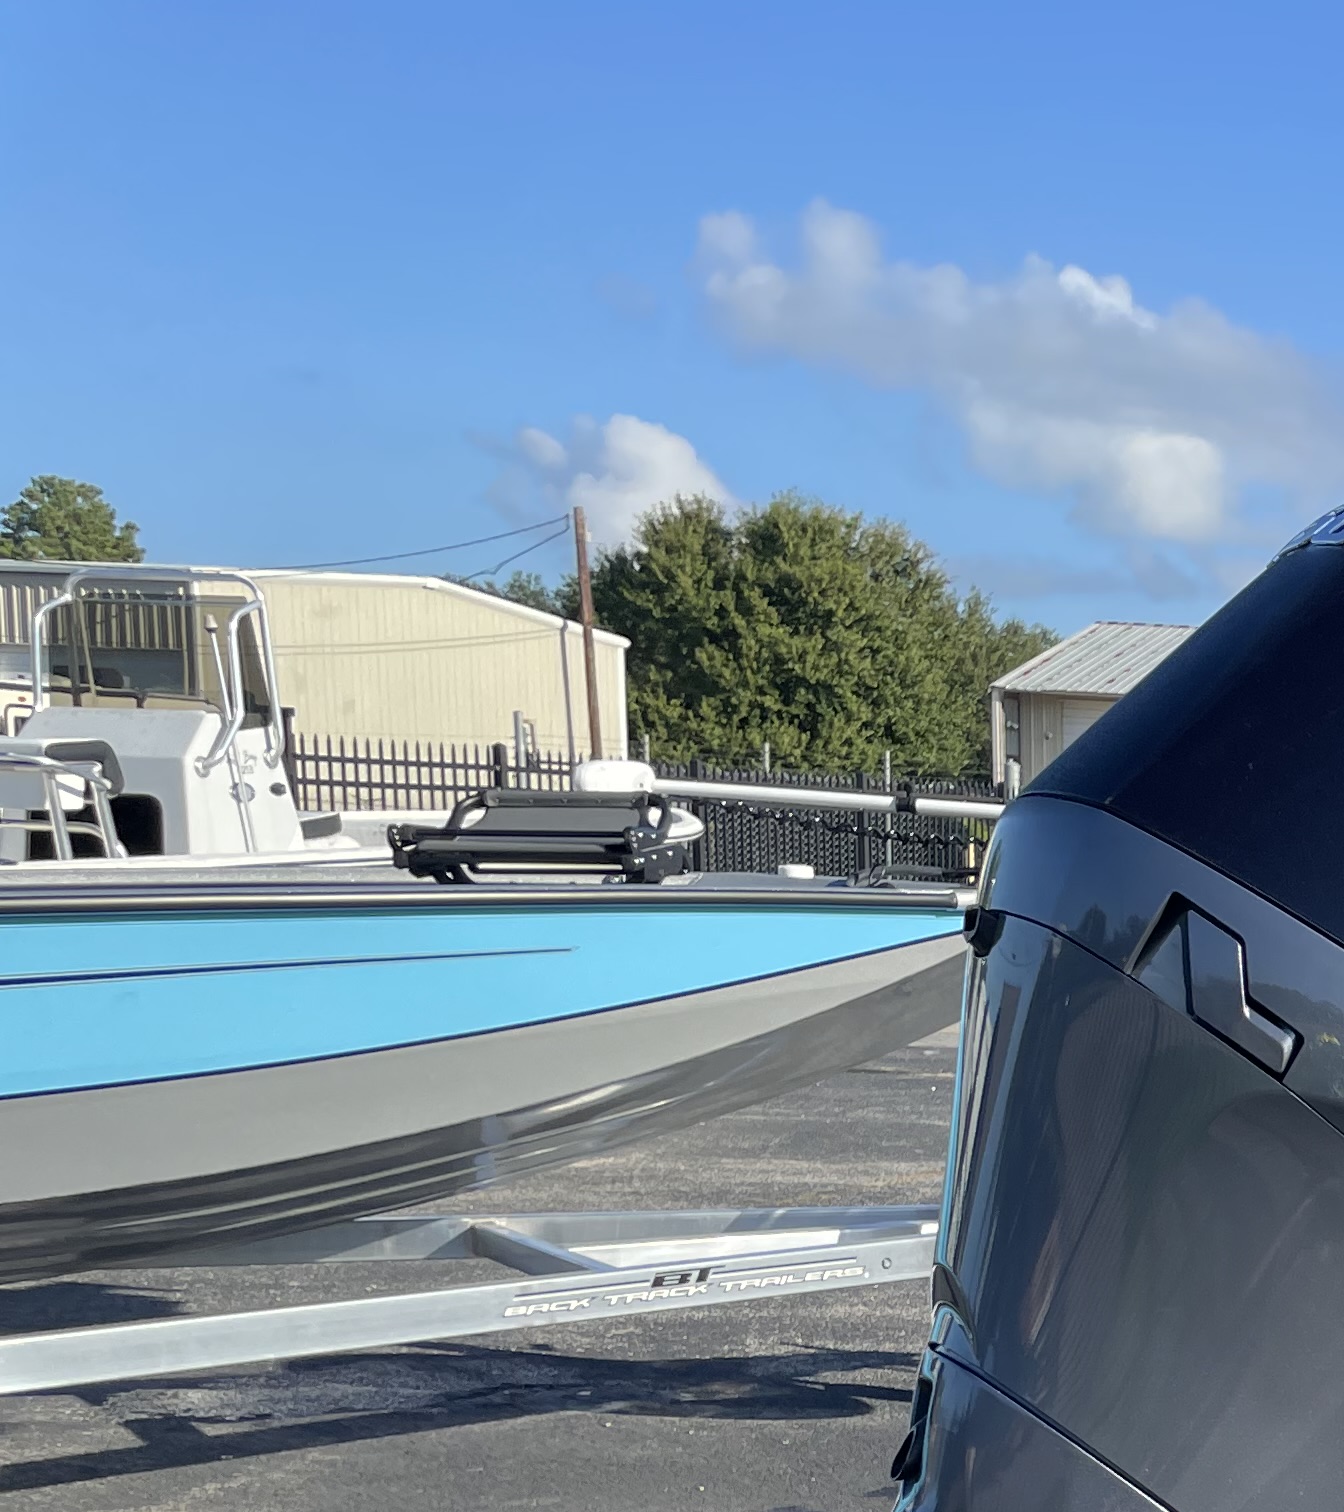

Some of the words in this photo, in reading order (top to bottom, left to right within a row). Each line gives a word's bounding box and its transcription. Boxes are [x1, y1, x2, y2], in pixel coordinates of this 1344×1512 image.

[502, 1296, 596, 1318] BACK
[602, 1283, 713, 1307] TRACK
[718, 1265, 865, 1293] TRAILERS
